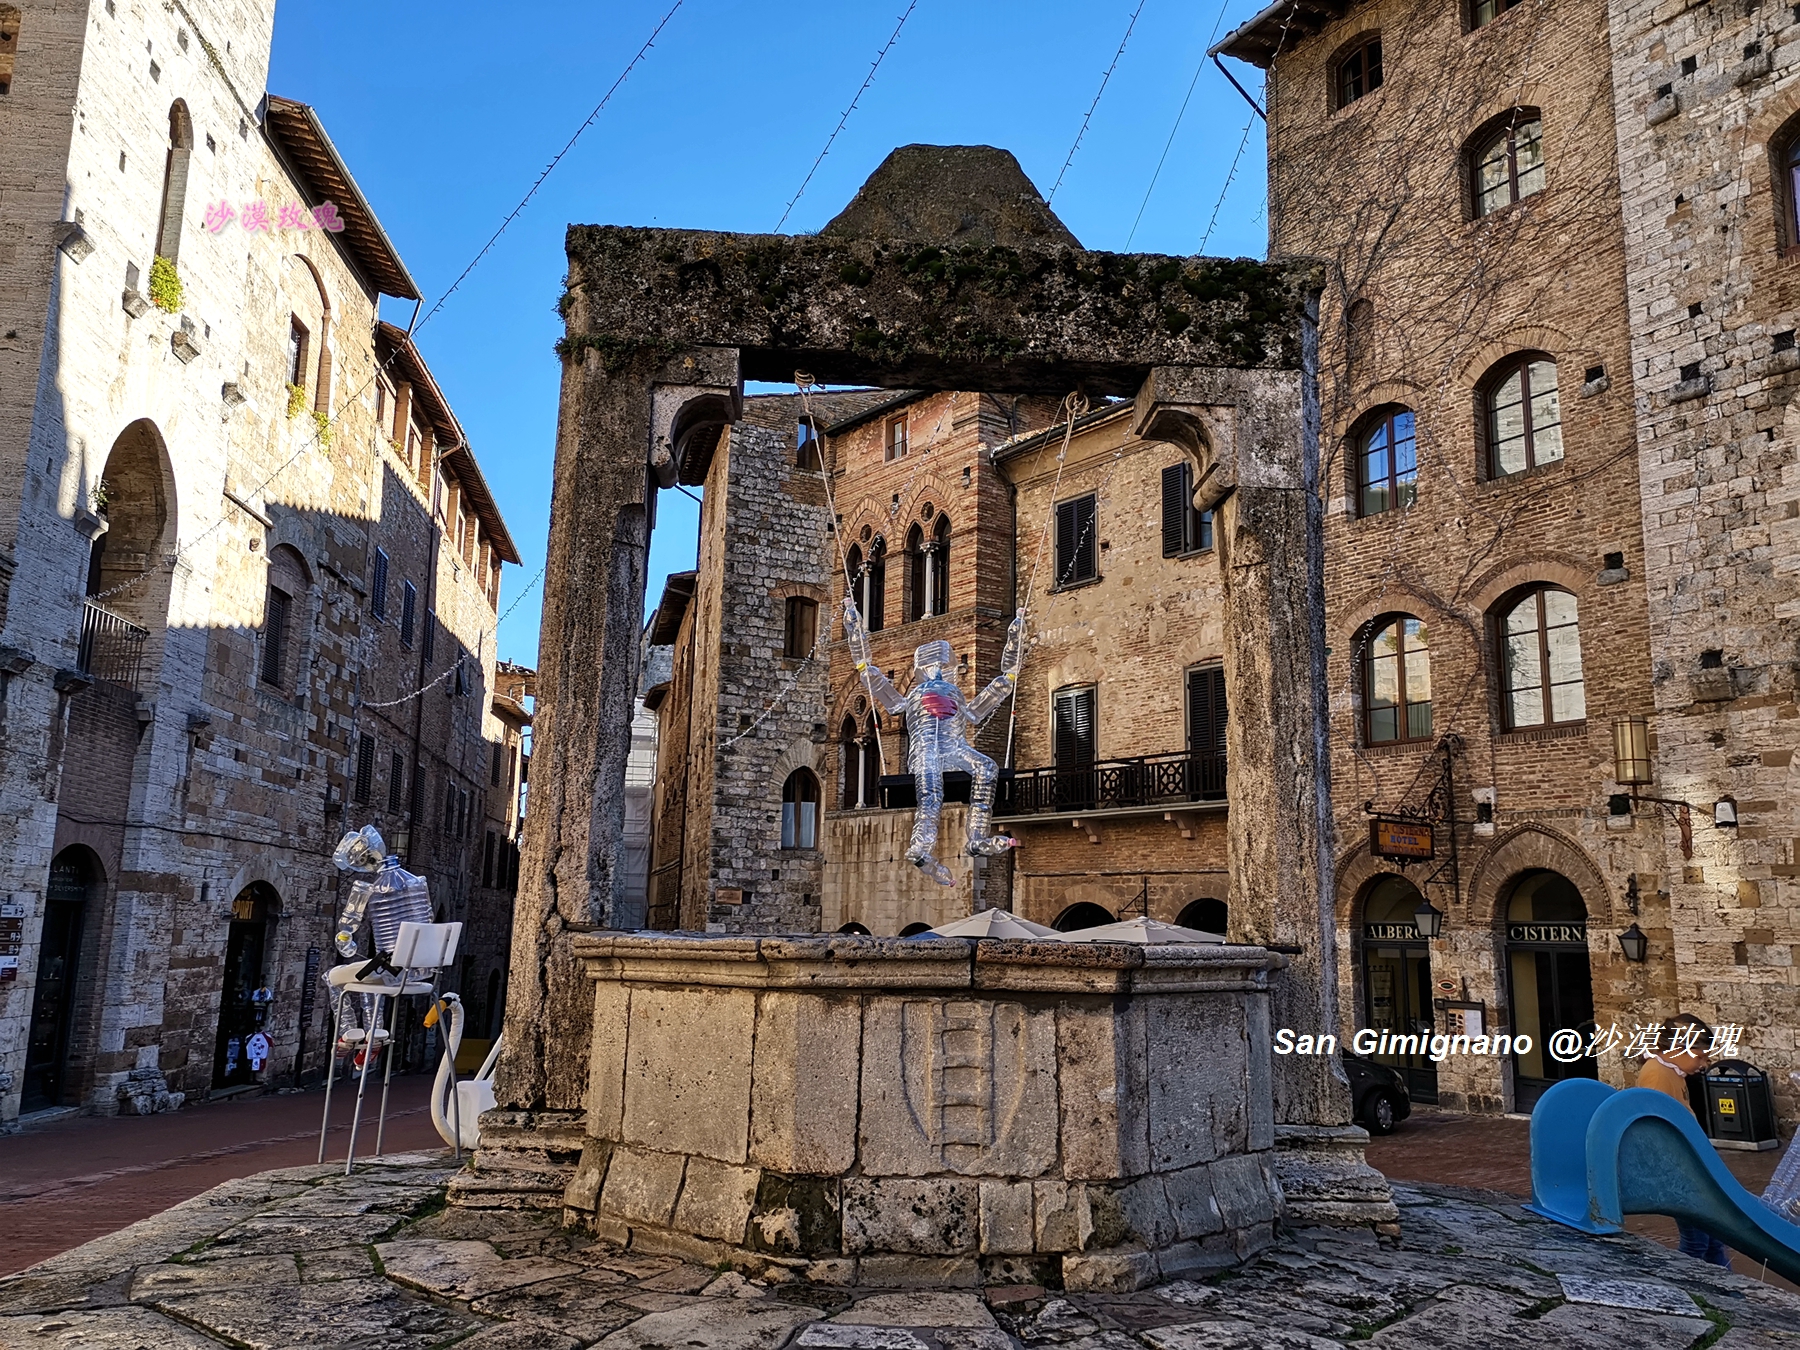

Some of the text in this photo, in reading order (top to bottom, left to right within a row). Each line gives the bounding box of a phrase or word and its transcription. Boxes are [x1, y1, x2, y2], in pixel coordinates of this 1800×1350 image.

[1390, 835, 1419, 846] HOTEL
[51, 865, 80, 875] LANTI
[232, 899, 254, 920] SPORT
